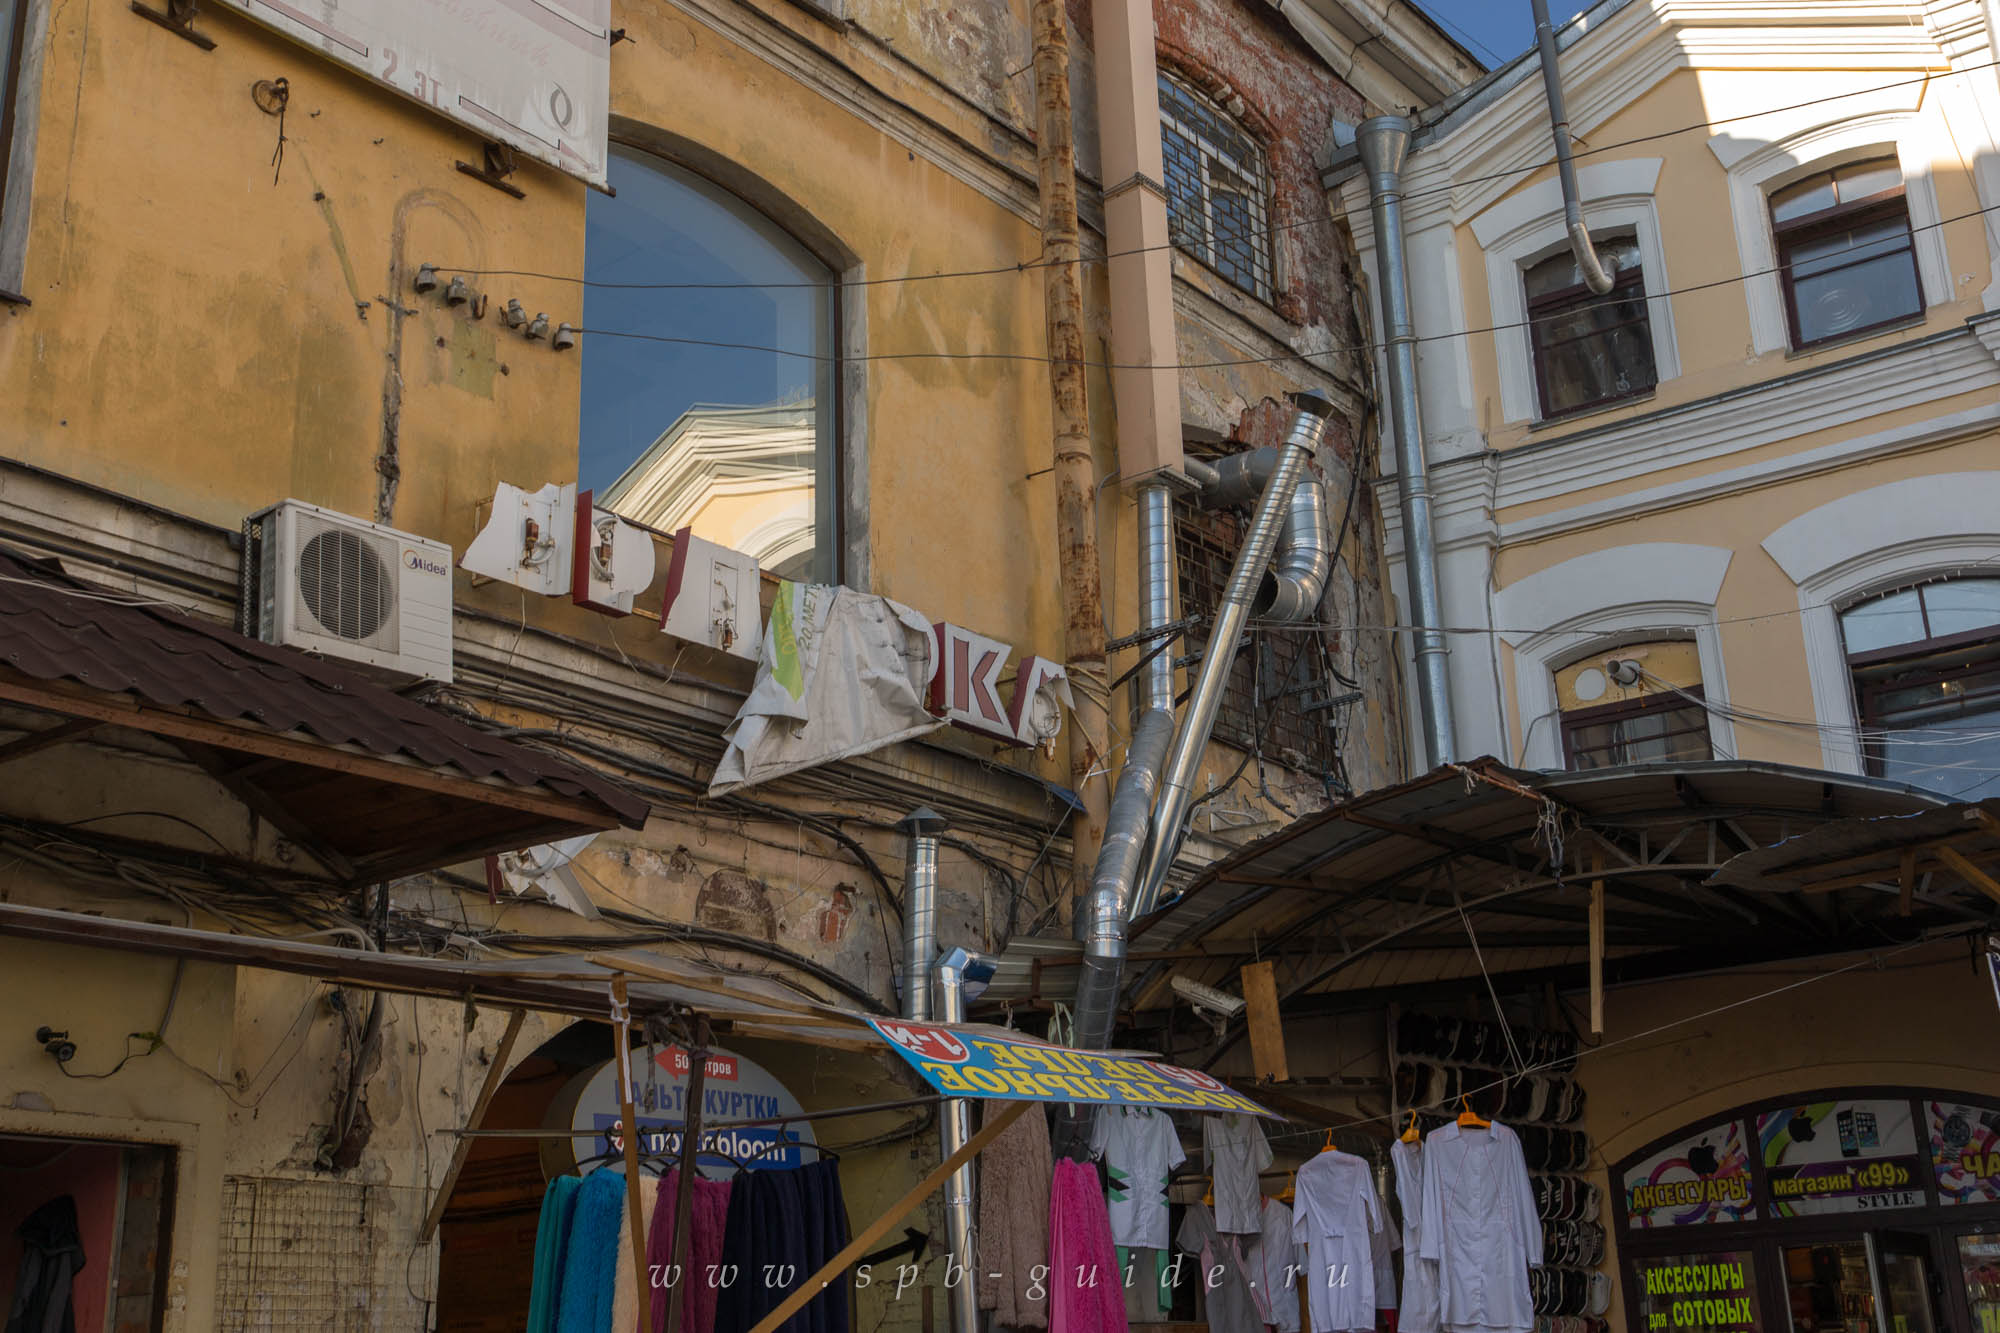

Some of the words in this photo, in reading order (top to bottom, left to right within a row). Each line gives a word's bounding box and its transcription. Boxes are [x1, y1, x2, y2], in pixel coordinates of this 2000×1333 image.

[382, 47, 398, 86] 2
[409, 556, 446, 576] Midea
[674, 1053, 689, 1069] 50
[704, 1059, 732, 1076] тров
[972, 1040, 1170, 1085] БЕЛЬЕ
[705, 1088, 779, 1119] КУРТКИ
[921, 1062, 1269, 1115] ПОСТЕЛЬНОЕ
[1632, 1176, 1747, 1210] АКСЕССУАРЫ
[1773, 1173, 1852, 1196] магазин
[1857, 1192, 1915, 1210] STYLE
[1646, 1263, 1745, 1295] АКСЕССУАРЫ
[1649, 1313, 1668, 1332] для
[1672, 1296, 1753, 1328] СОТОВЫХ
